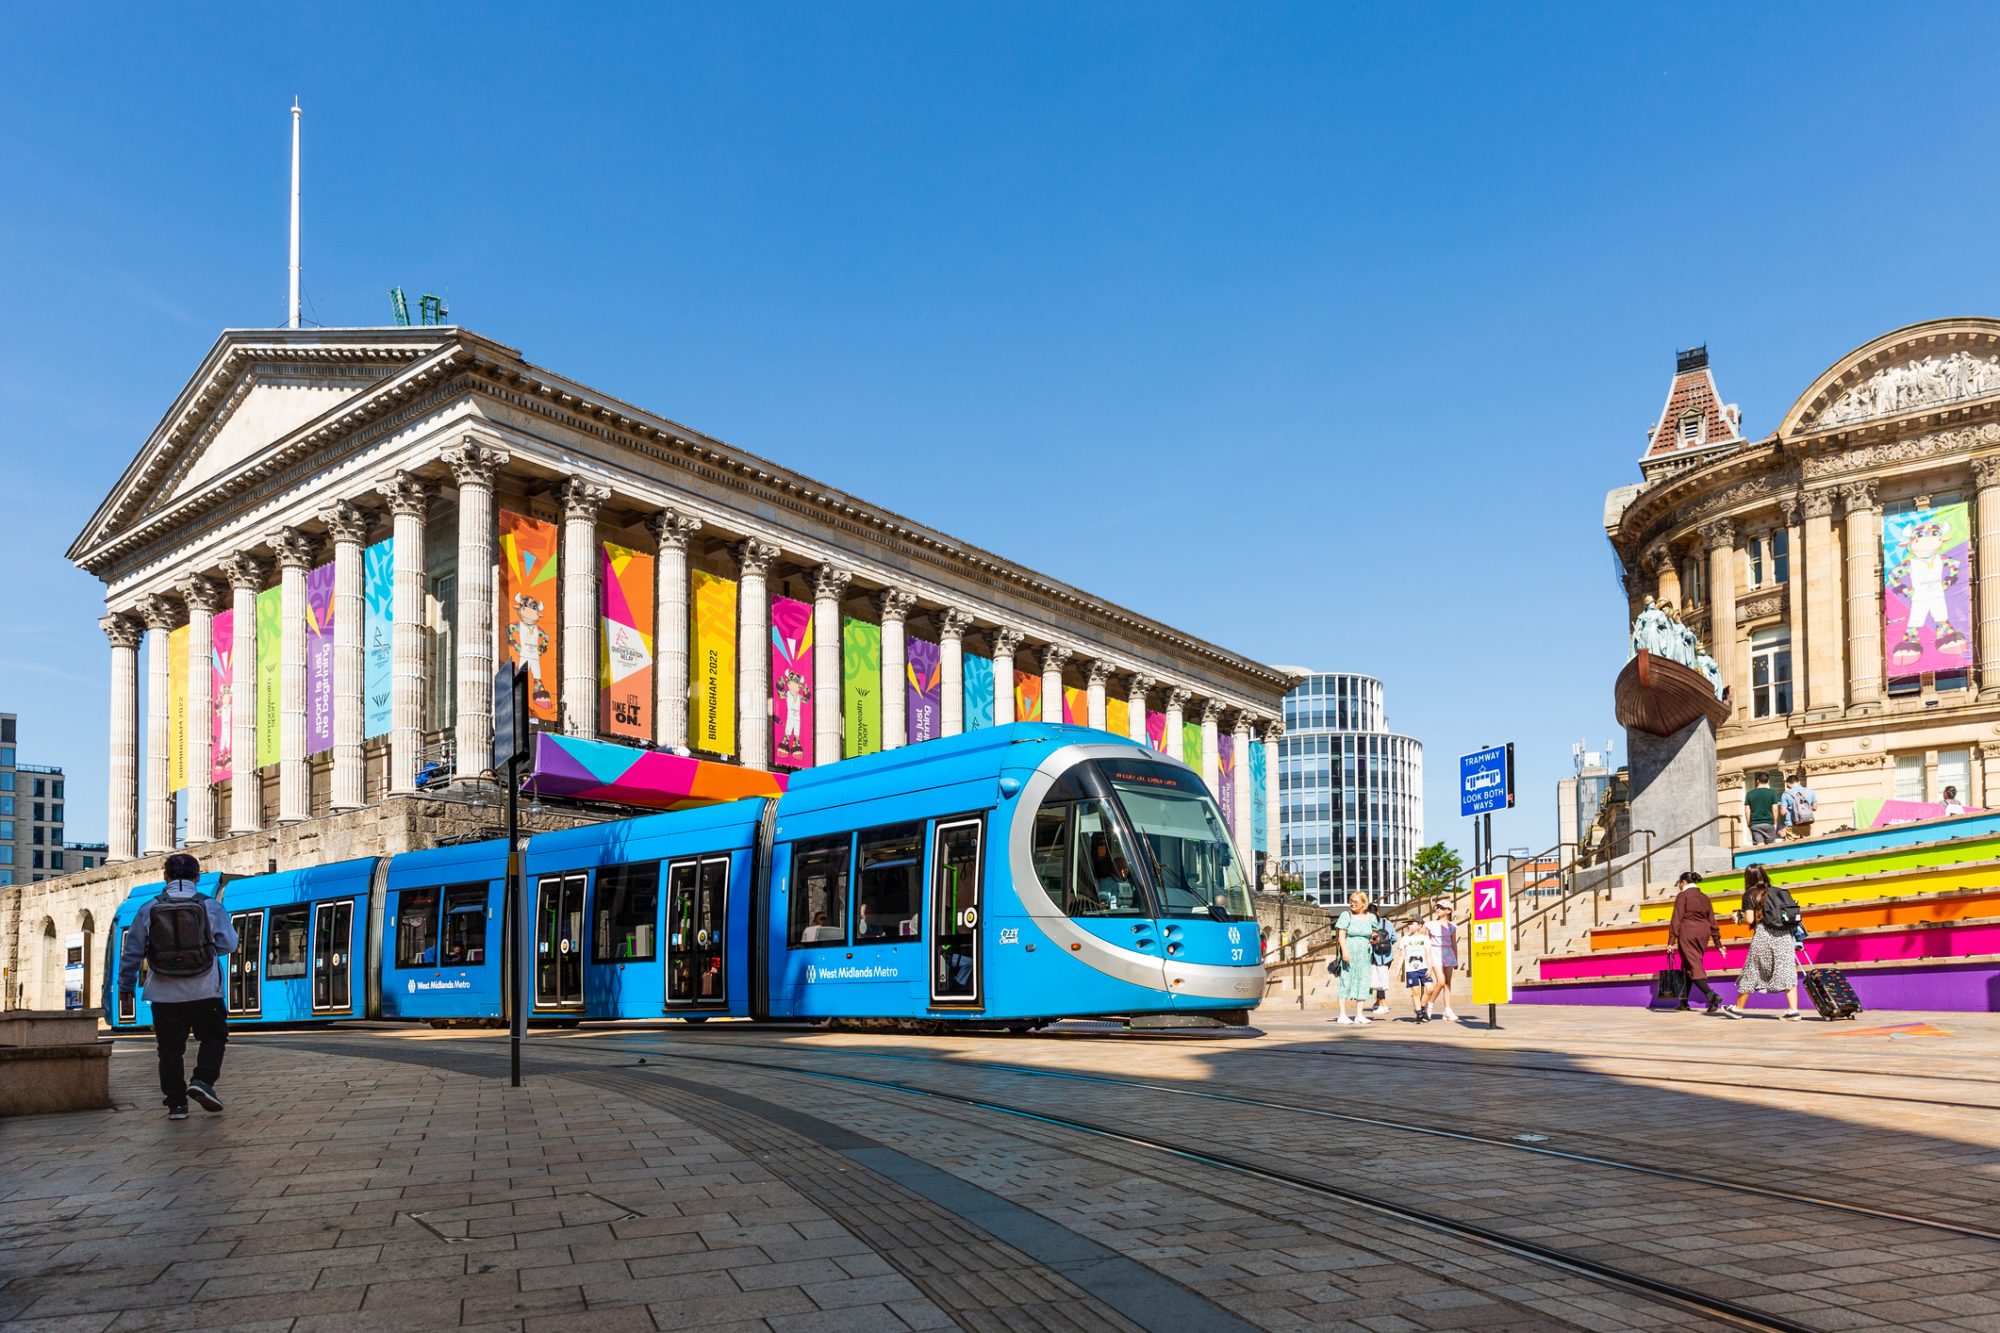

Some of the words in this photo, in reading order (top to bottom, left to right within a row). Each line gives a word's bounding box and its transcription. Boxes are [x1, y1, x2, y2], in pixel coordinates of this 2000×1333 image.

[314, 652, 323, 678] just
[708, 649, 718, 675] 2022
[321, 643, 330, 713] beginning
[314, 681, 322, 692] is
[314, 696, 323, 734] sport
[627, 704, 640, 715] IT
[708, 677, 718, 740] BIRMINGHAM
[321, 715, 329, 739] the
[615, 712, 641, 727] ON.
[915, 709, 924, 730] just
[922, 705, 932, 740] inning
[1465, 750, 1500, 766] TRAMWAY
[1463, 793, 1482, 804] LOOK
[1484, 788, 1504, 799] BOTH
[1473, 799, 1494, 811] WAYS
[1231, 949, 1243, 960] 37
[819, 968, 837, 978] West
[838, 966, 872, 978] Midlands
[873, 966, 898, 977] Metro
[417, 981, 430, 990] West
[430, 980, 453, 989] Midlands
[454, 980, 470, 989] Metro
